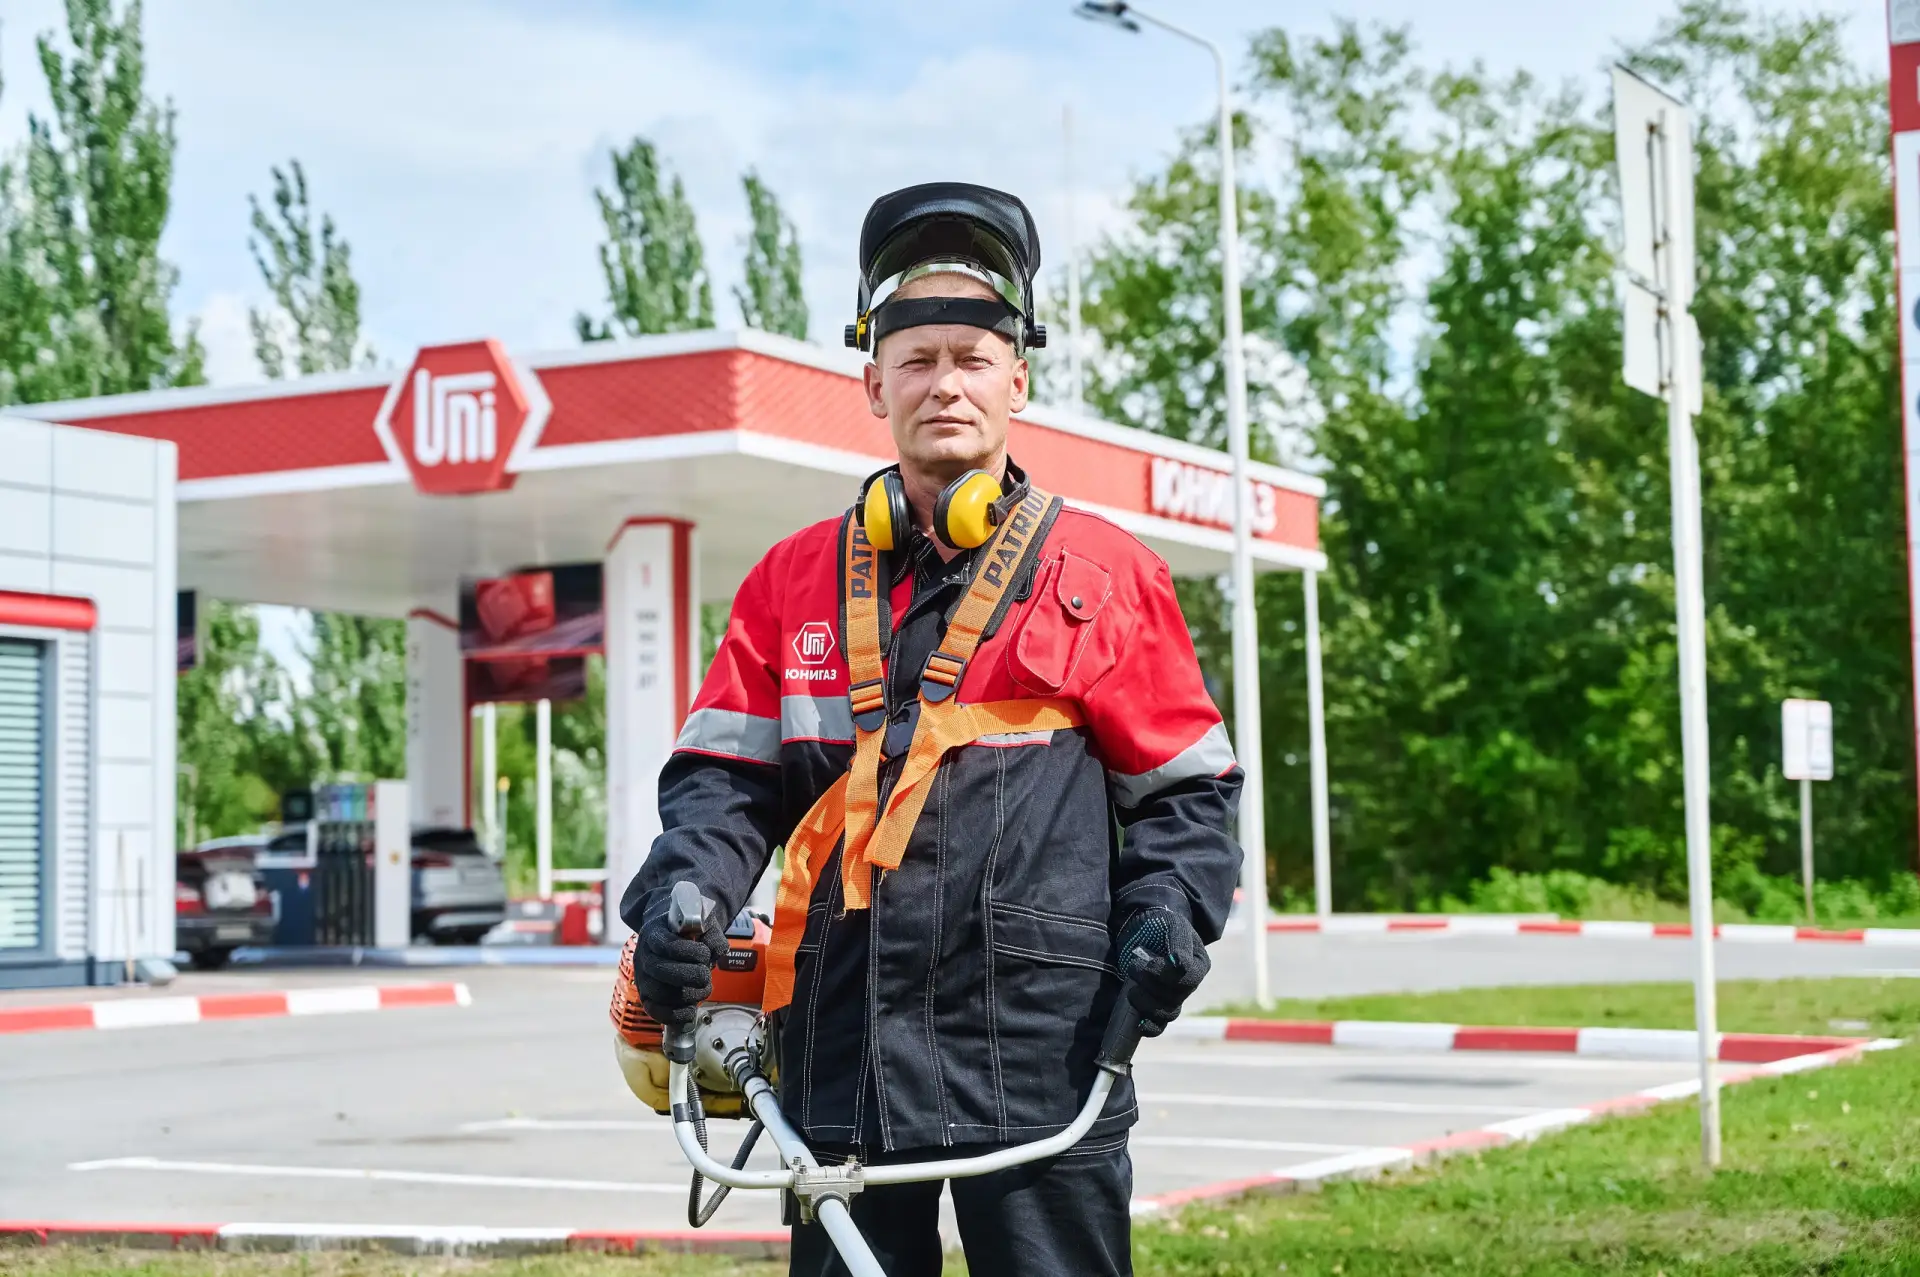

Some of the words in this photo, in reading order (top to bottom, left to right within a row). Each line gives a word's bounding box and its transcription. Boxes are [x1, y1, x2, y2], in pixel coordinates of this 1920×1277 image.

[414, 368, 497, 467] Uni
[1151, 456, 1278, 533] ЮНИЗ
[802, 631, 825, 656] Uni
[785, 668, 837, 681] ЮНИГАЗ
